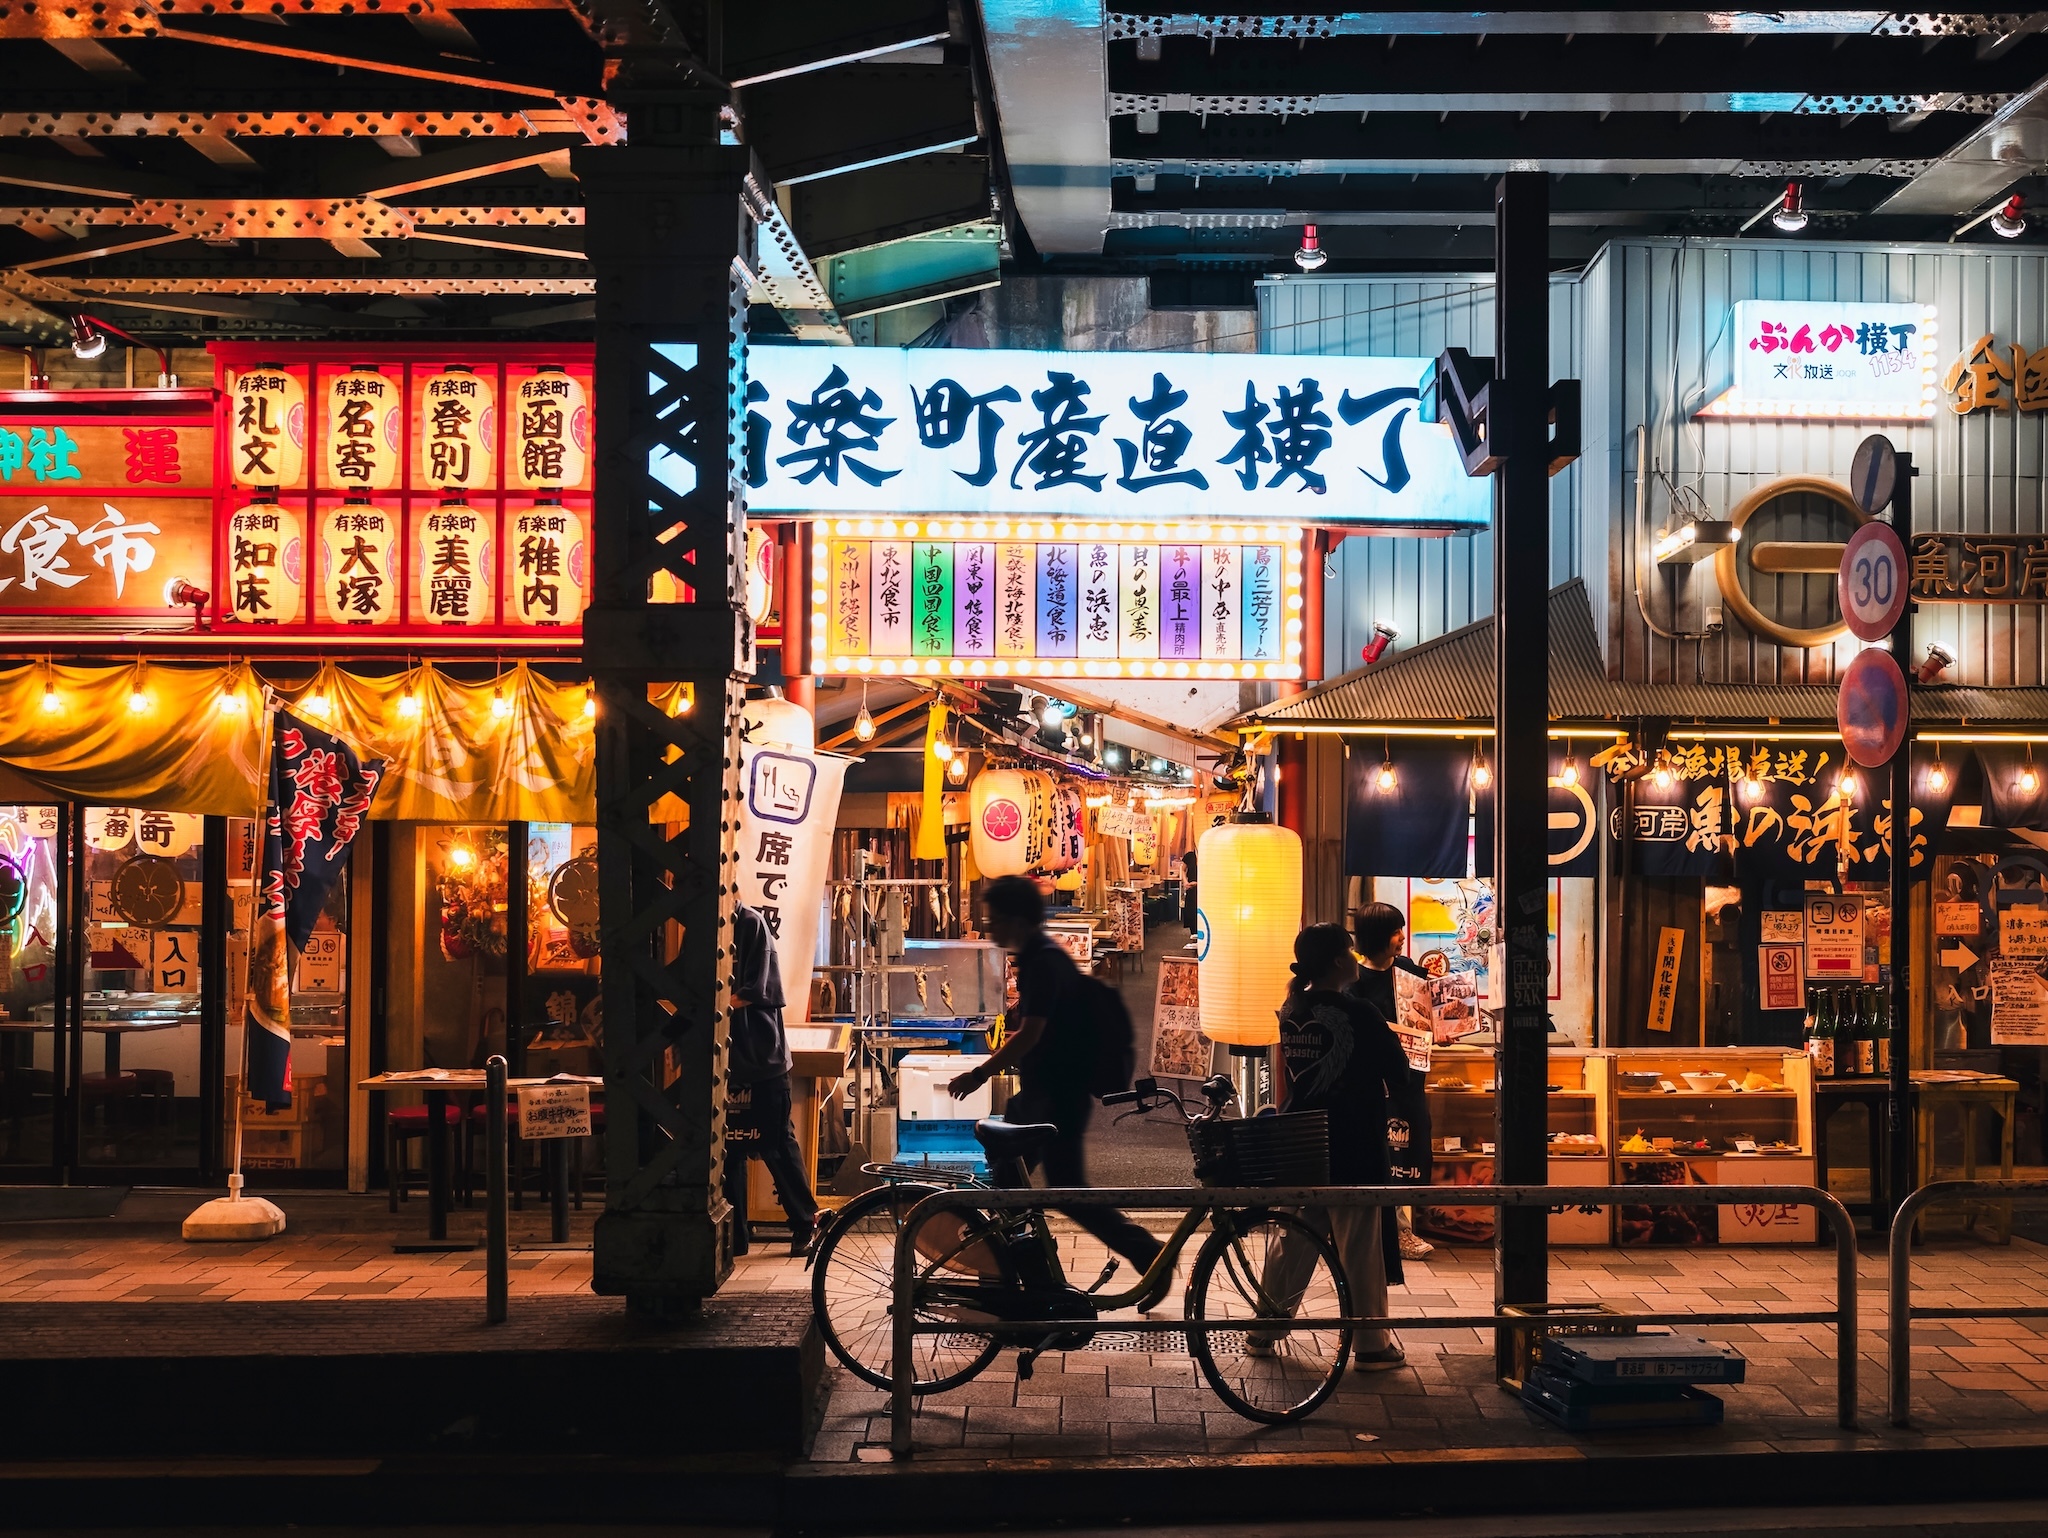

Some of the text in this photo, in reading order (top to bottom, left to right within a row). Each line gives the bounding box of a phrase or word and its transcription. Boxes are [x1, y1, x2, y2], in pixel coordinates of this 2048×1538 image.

[1750, 321, 1917, 356] ぶんか横丁
[1868, 349, 1917, 378] 1134
[237, 374, 287, 394] 有楽町
[335, 377, 385, 398] 有楽町
[428, 379, 478, 398] 有楽町
[520, 380, 571, 399] 有楽町
[1773, 357, 1834, 380] 文化放送
[123, 428, 182, 484] 運
[238, 396, 282, 476] 礼文
[335, 400, 377, 482] 名寄
[430, 399, 472, 483] 登別
[521, 399, 567, 481] 函館
[747, 363, 1420, 495] 楽町産直横丁
[233, 514, 280, 533] 有楽町
[334, 513, 385, 533] 有楽町
[428, 514, 477, 533] 有楽町
[517, 515, 568, 534] 有楽町
[0, 503, 161, 600] 食市
[234, 535, 277, 614] 知床
[336, 535, 383, 616] 大塚
[430, 534, 472, 617] 美麗
[519, 535, 562, 617] 稚内
[880, 544, 902, 630] 東北食市
[922, 544, 945, 655] 中国四国食市
[1046, 546, 1069, 648] 北海道食市
[1086, 543, 1112, 643] 魚の浜恵
[1853, 554, 1893, 608] 30
[1606, 743, 1830, 787] 全漁場直送!
[162, 936, 189, 988] 入口
[1282, 1031, 1323, 1046] Beautiful
[1283, 1046, 1321, 1059] Disaster
